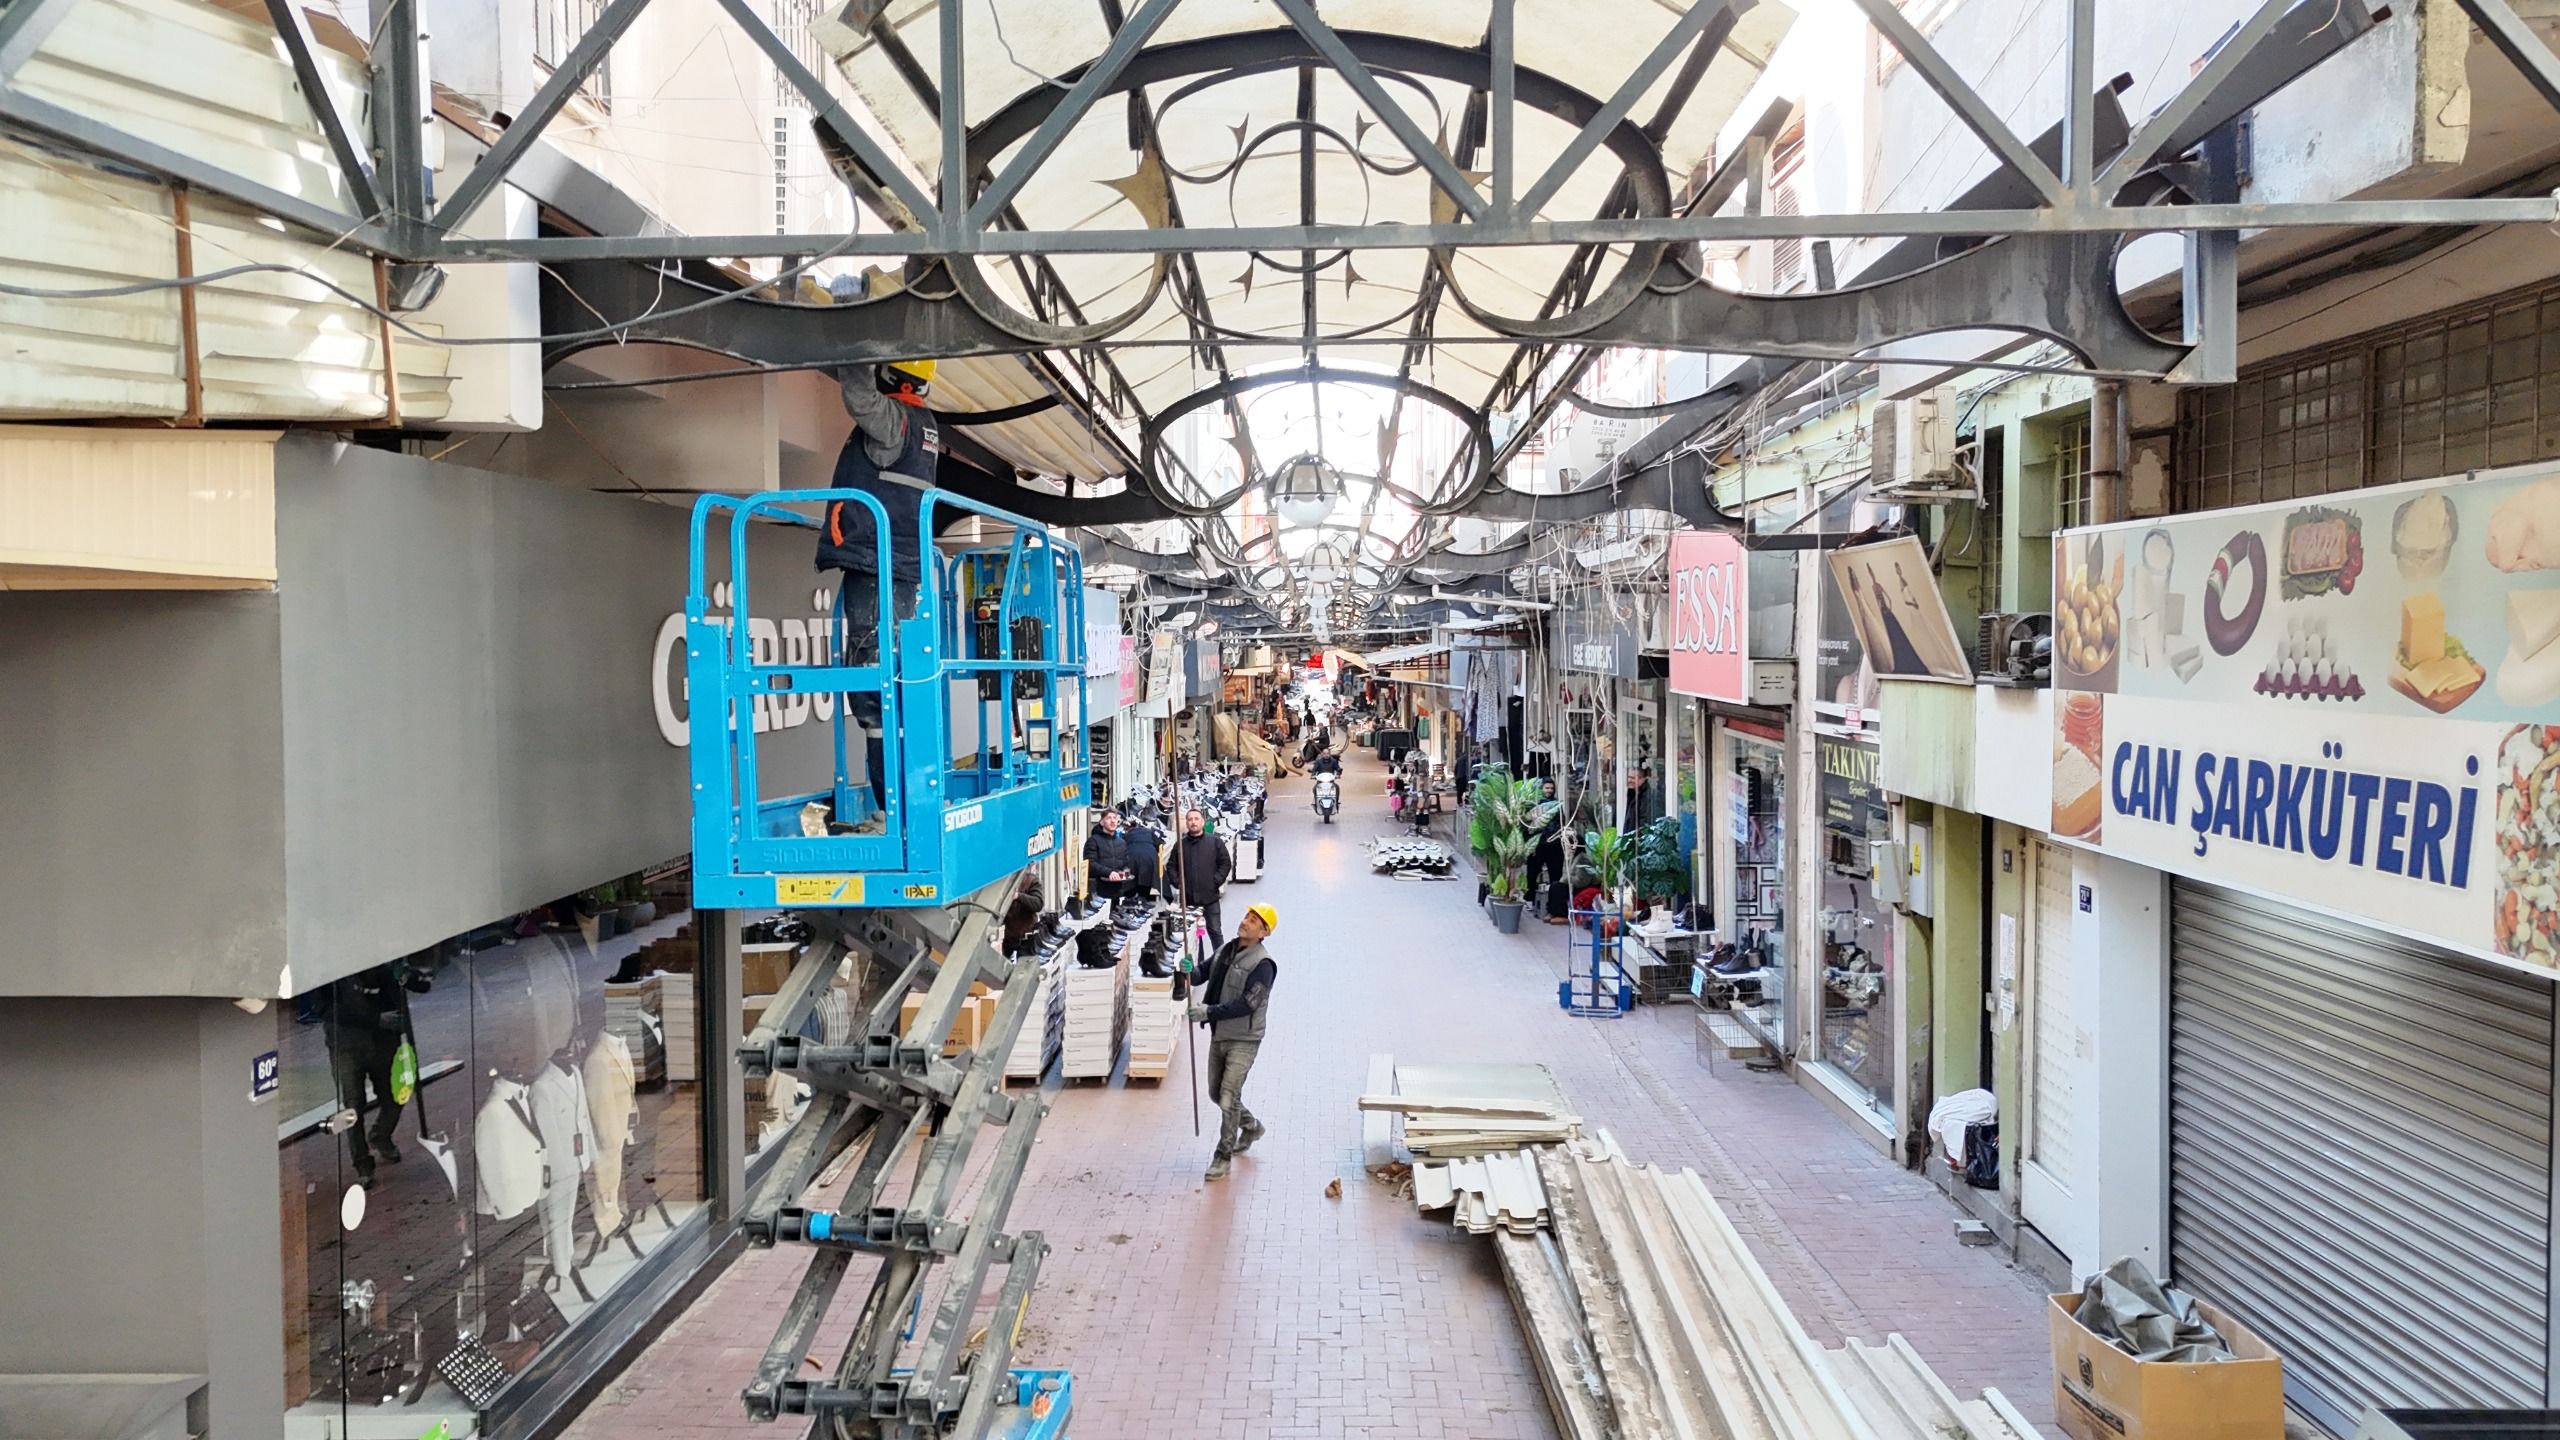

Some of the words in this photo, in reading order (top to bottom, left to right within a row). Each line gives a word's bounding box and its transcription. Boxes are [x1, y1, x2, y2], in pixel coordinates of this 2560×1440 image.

[1673, 562, 1738, 654] ESSA
[1823, 742, 1881, 786] TAKINT
[2110, 740, 2182, 827] CAN
[2190, 740, 2480, 890] ŞARKÜTERİ
